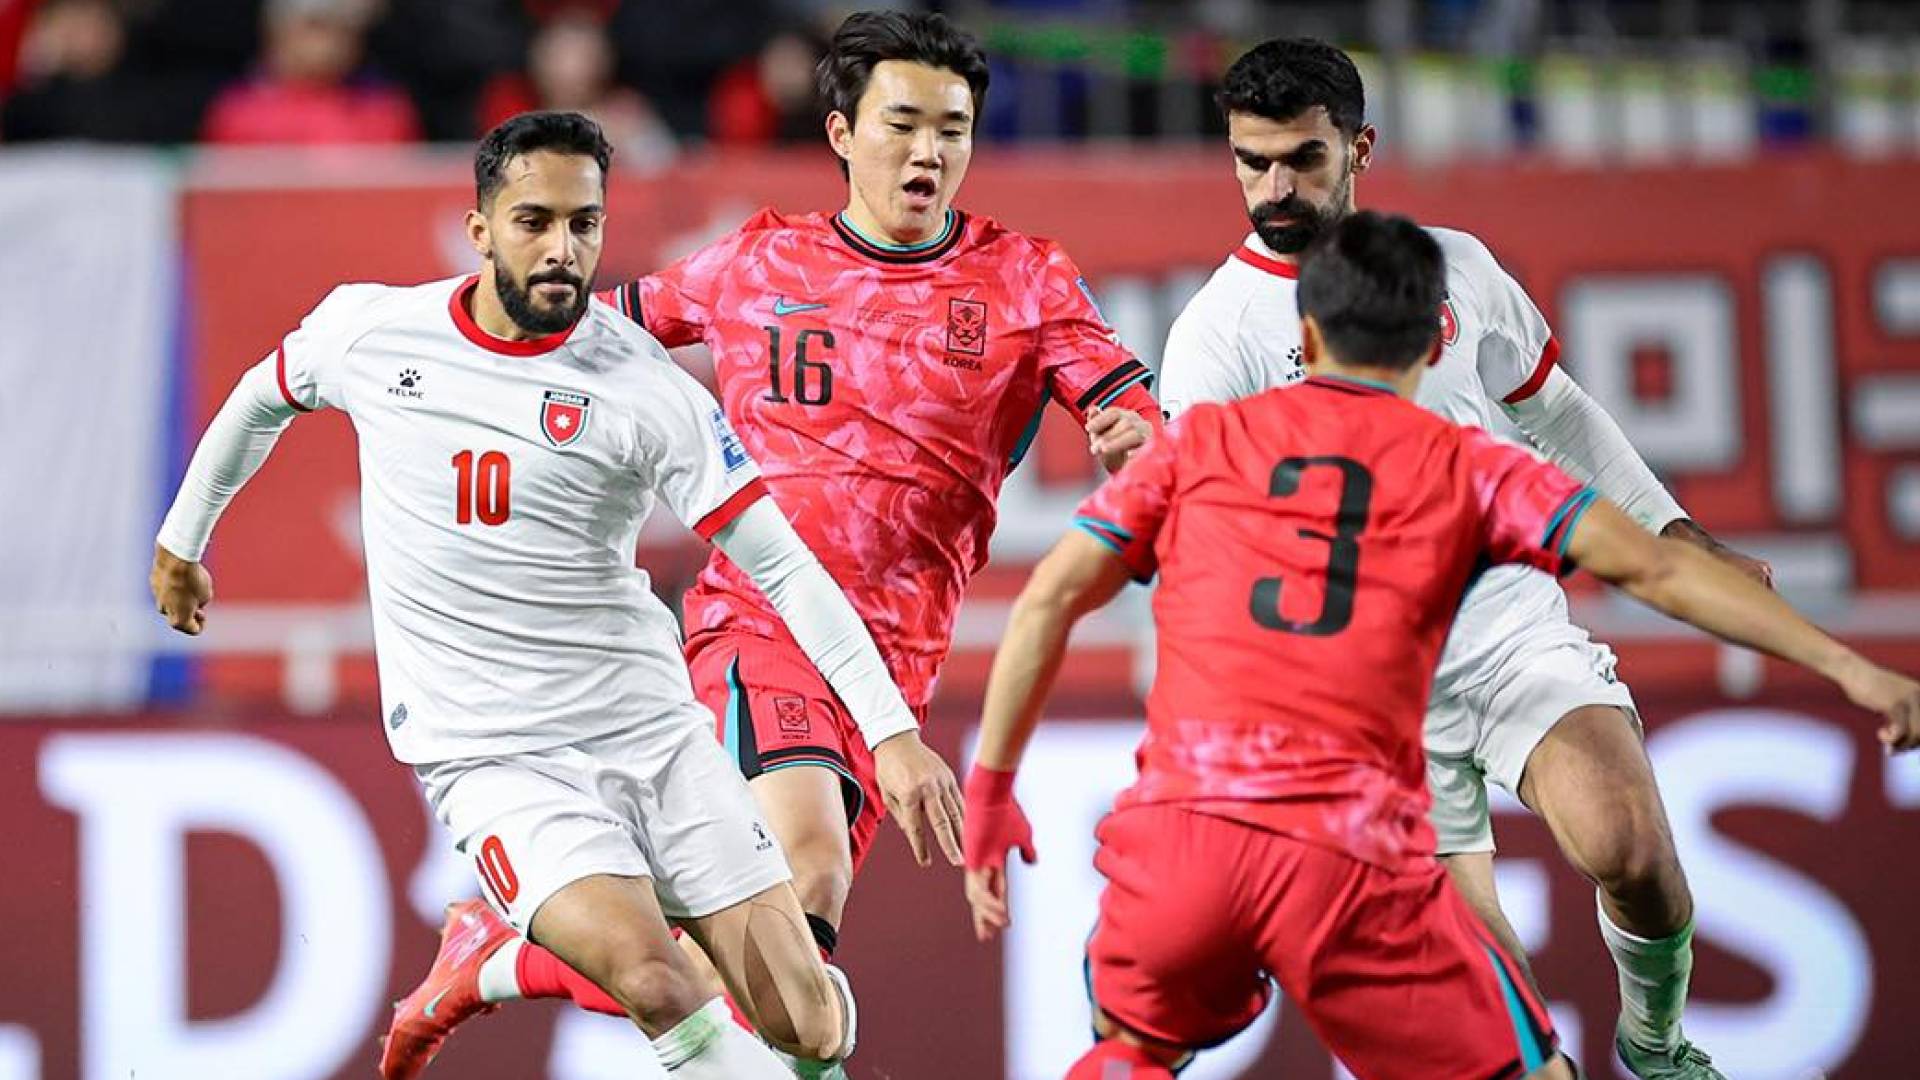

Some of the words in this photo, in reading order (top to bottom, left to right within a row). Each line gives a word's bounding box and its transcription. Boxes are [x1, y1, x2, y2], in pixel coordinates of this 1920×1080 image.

[387, 386, 425, 400] KELME
[763, 326, 835, 405] 16
[943, 356, 983, 371] KOREA
[451, 449, 511, 526] 10
[1249, 456, 1375, 637] 3
[474, 834, 519, 916] 10
